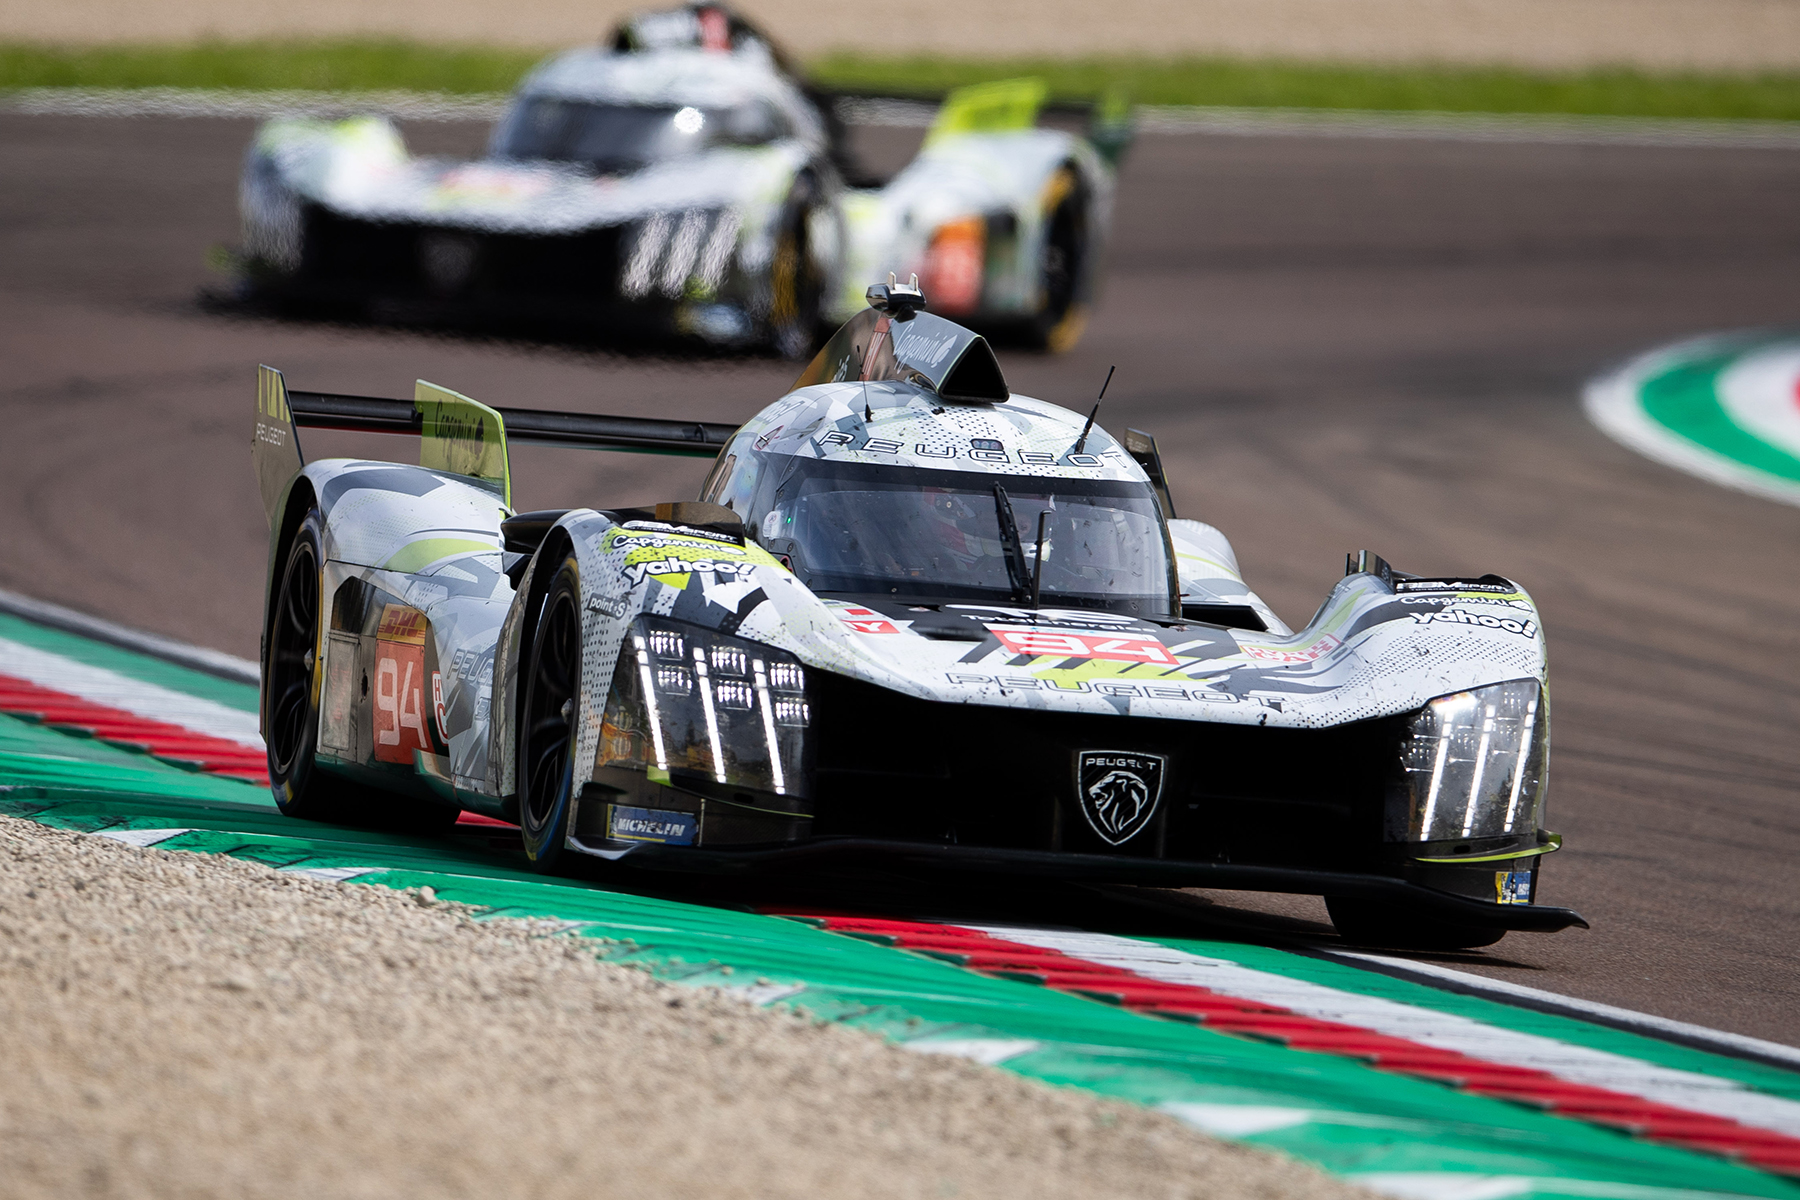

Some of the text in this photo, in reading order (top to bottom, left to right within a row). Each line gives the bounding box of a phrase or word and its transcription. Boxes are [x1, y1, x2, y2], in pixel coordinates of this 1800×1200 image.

[256, 422, 287, 447] PEUGEOT
[818, 429, 1128, 469] PEUGEOT
[612, 534, 720, 552] Capgemini
[621, 555, 757, 589] yahoo!
[589, 595, 614, 613] point
[1400, 596, 1509, 608] Capgemini
[384, 610, 419, 638] DHL
[961, 614, 1157, 633] TotalEnergies
[1410, 610, 1539, 639] yahoo!
[1003, 632, 1169, 662] 94
[377, 658, 429, 748] 94
[946, 672, 1287, 712] PEUGEOT
[618, 818, 686, 837] MICHELIN
